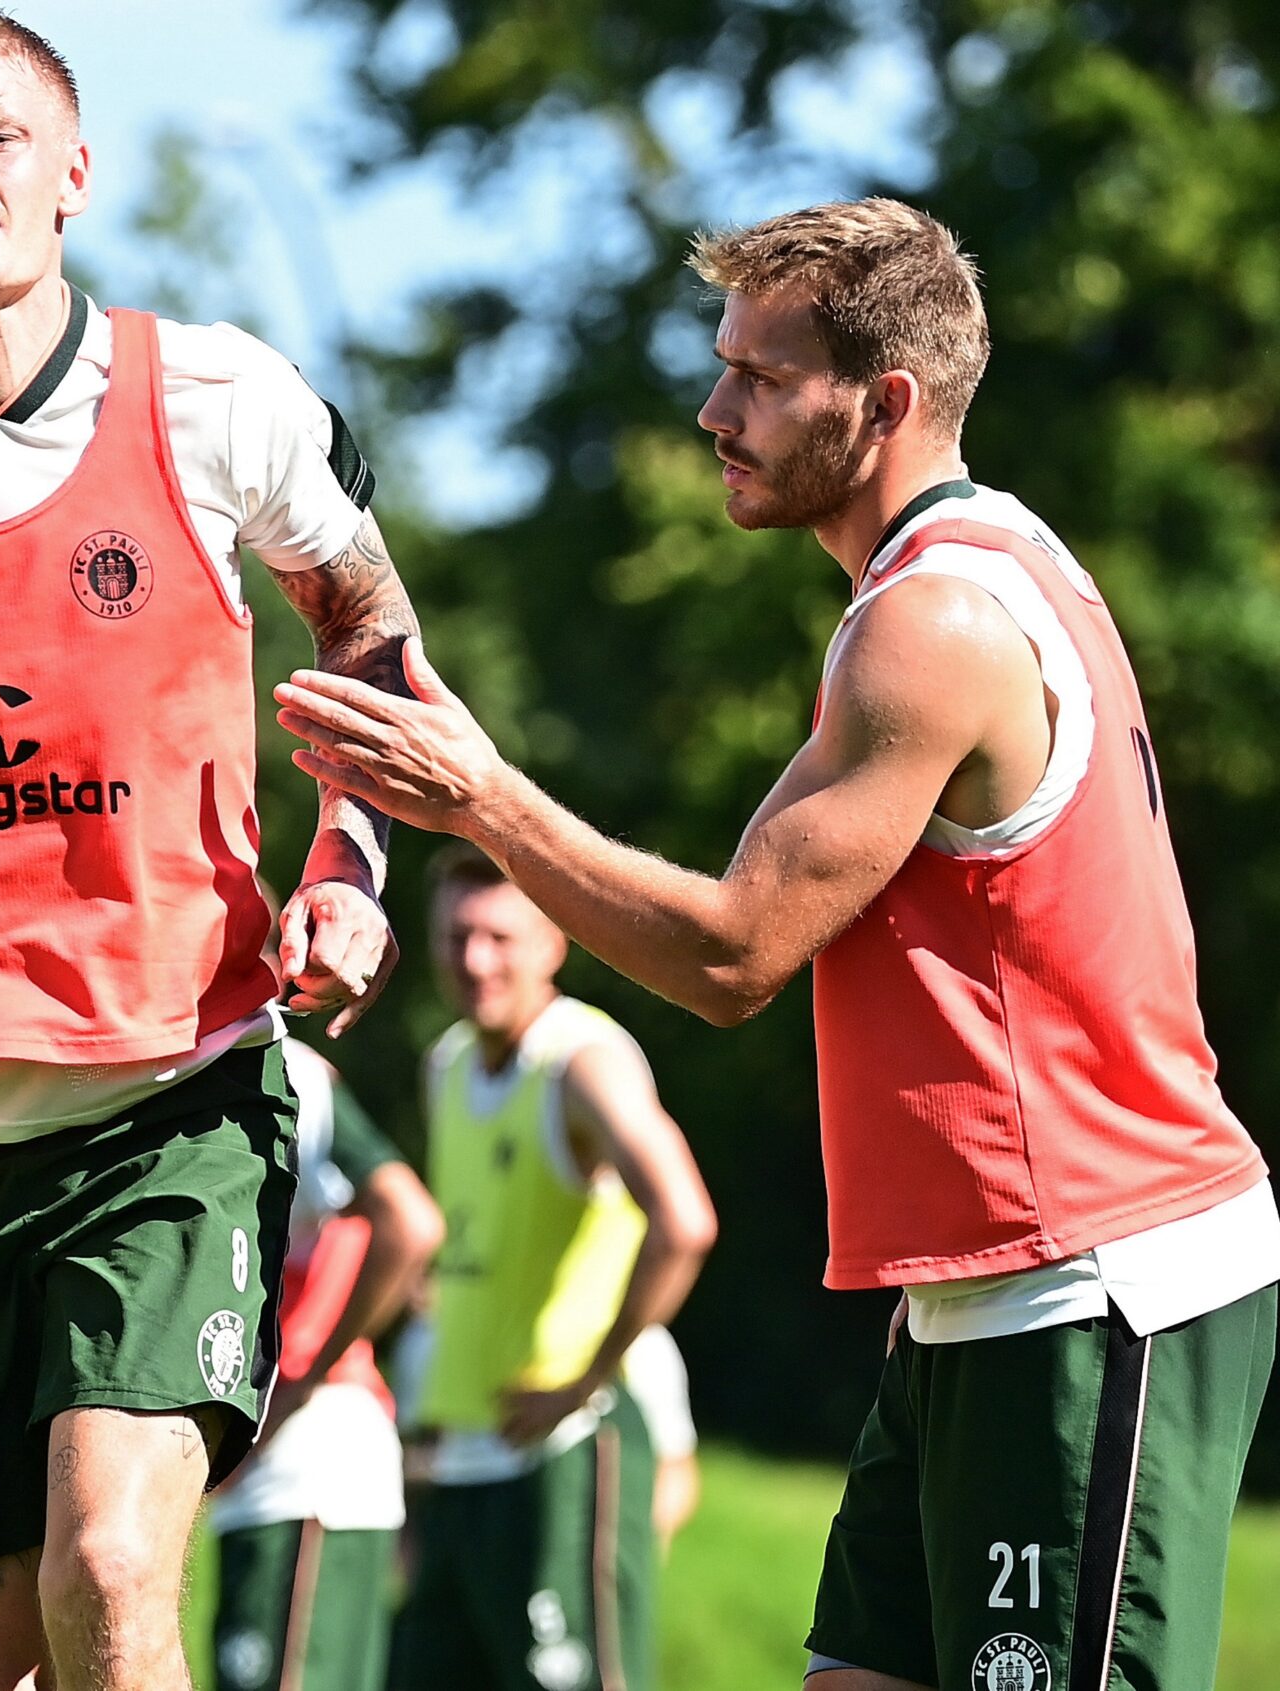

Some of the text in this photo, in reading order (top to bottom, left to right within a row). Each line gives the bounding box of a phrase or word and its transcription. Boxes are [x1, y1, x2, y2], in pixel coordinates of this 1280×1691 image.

[74, 535, 149, 575] FC ST. PAULI
[99, 601, 133, 615] 1910
[231, 1227, 249, 1293] 8
[988, 1541, 1040, 1609] 21
[975, 1637, 1046, 1677] FC ST. PAULI
